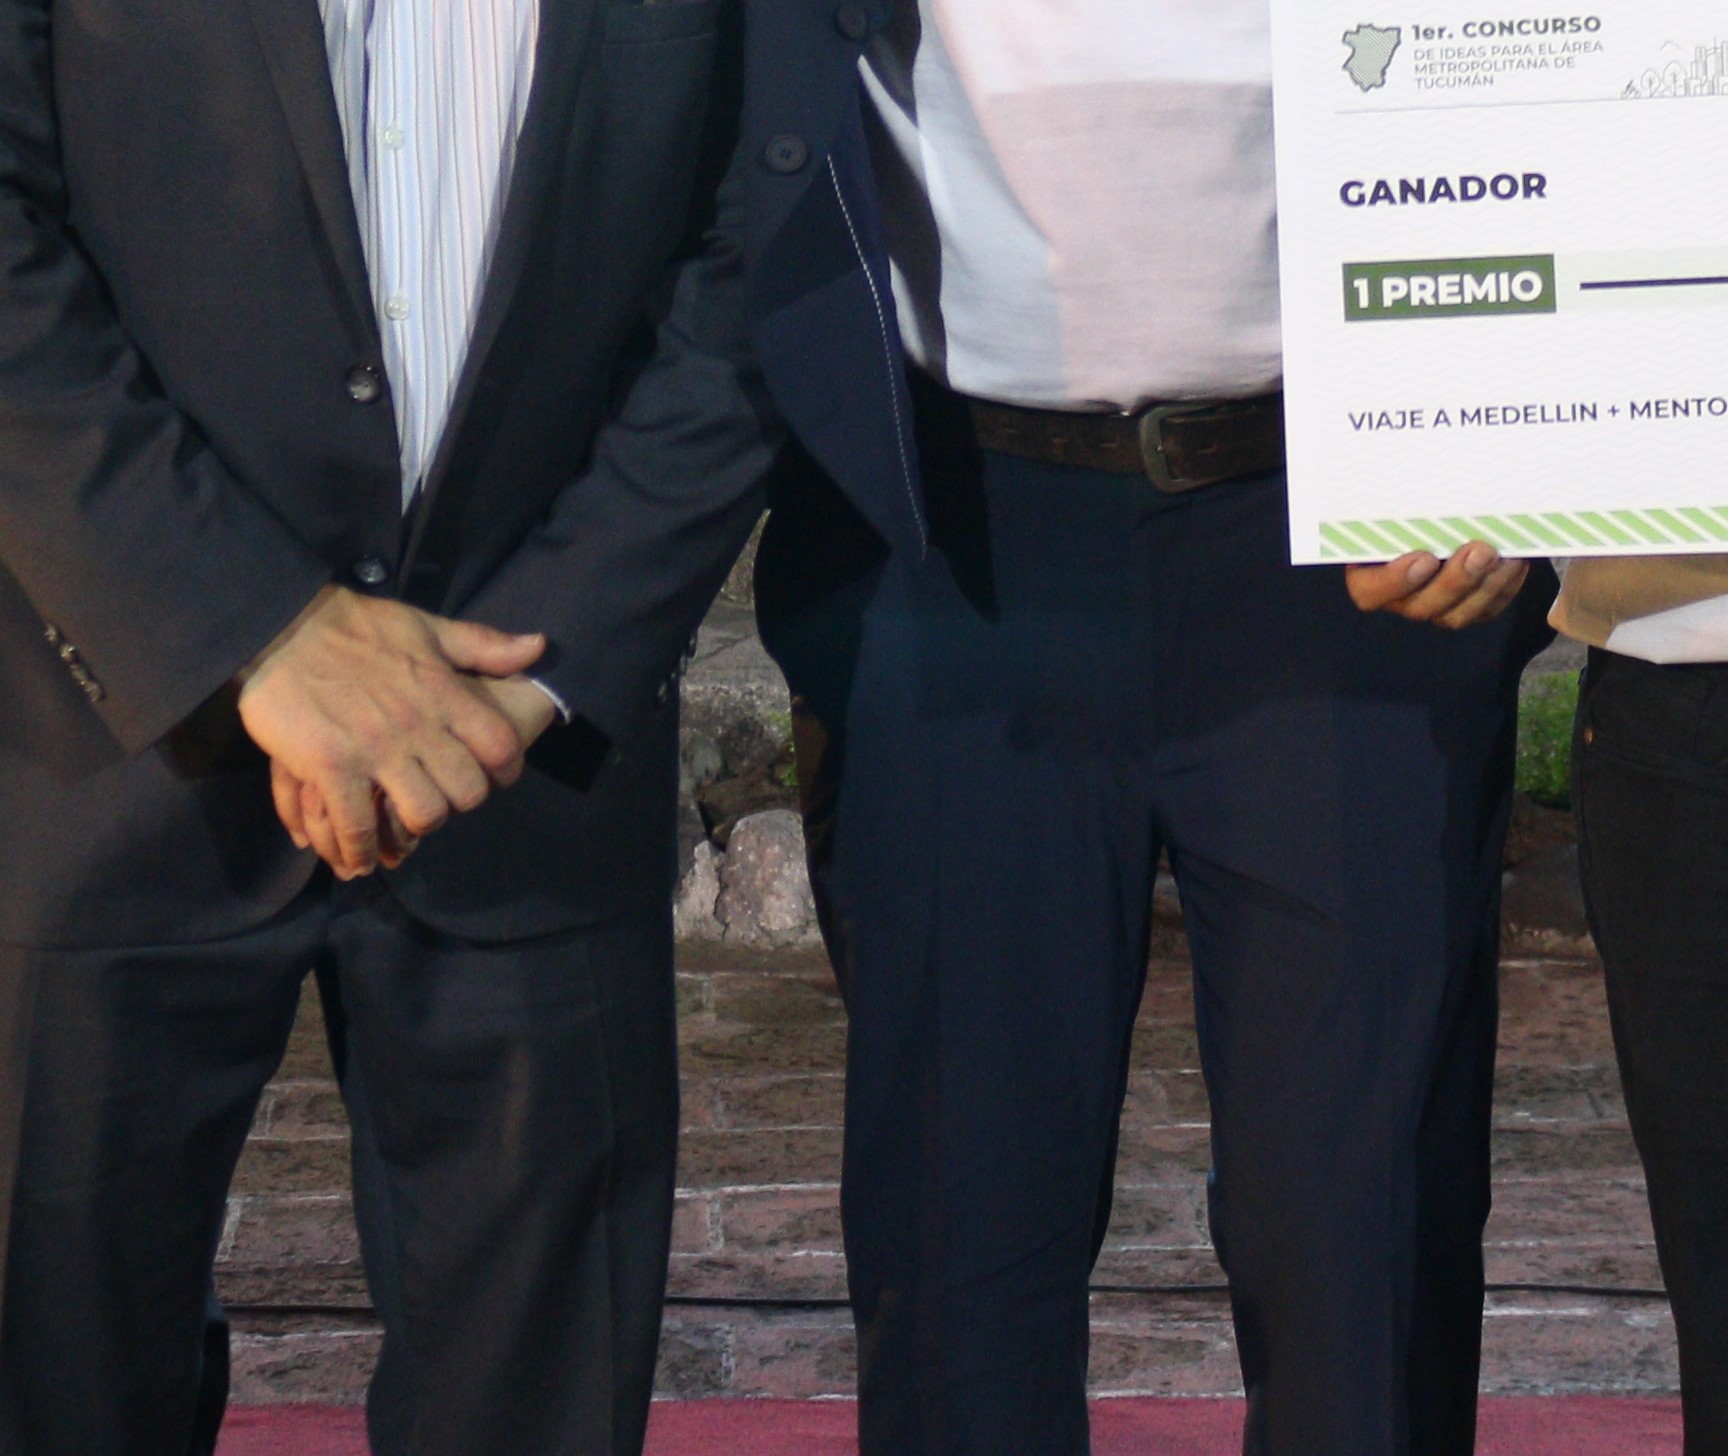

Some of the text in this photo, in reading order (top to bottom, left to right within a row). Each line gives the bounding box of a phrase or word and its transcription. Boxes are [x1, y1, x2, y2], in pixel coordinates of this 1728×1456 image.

[1412, 16, 1602, 41] 1er. CONCURSO
[1414, 48, 1434, 61] DE
[1440, 45, 1486, 59] IDEAS
[1491, 43, 1533, 57] PARA
[1539, 43, 1557, 55] EL
[1414, 56, 1575, 76] METROPOLITANA DE
[1415, 74, 1494, 89] TUCUMÁN
[1340, 173, 1547, 207] GANADOR
[1353, 278, 1369, 309] 1
[1382, 271, 1543, 308] PREMIO
[1348, 409, 1425, 431] VIAJE
[1433, 408, 1452, 427] A
[1460, 402, 1598, 427] MEDELLIN
[1608, 405, 1620, 417] +
